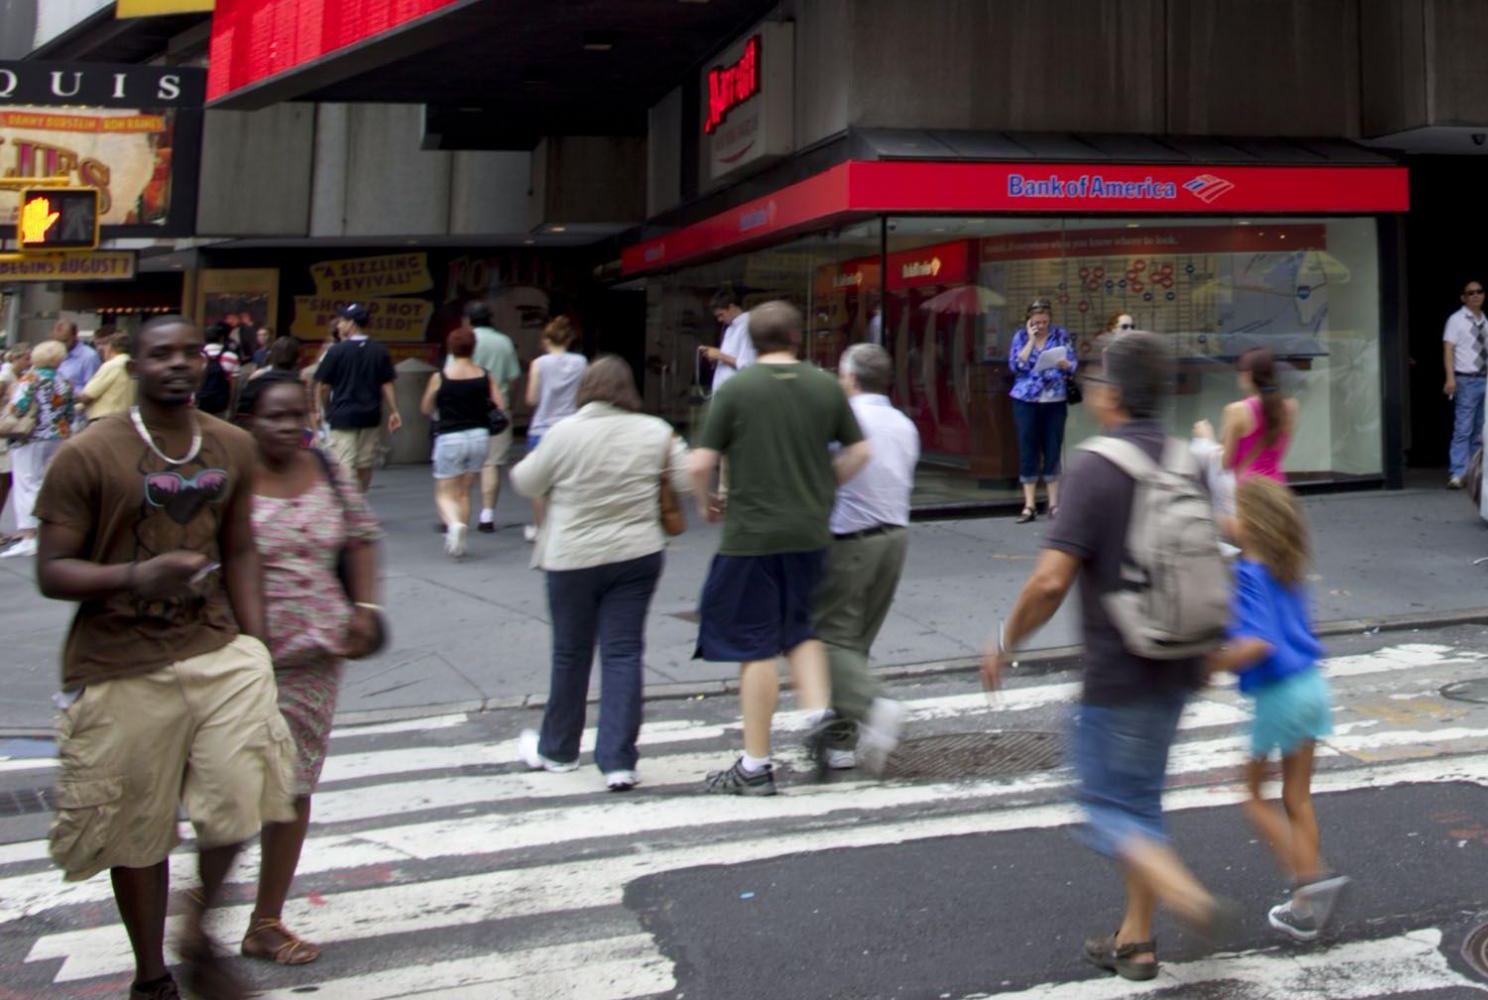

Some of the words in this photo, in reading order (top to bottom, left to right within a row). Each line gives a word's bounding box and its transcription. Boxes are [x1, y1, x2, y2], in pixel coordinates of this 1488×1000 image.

[1007, 173, 1066, 198] Bank
[1066, 173, 1090, 199] of
[1090, 174, 1177, 199] America
[59, 257, 116, 274] AUGUST
[340, 256, 419, 276] SIZZLING
[387, 303, 422, 316] NOT
